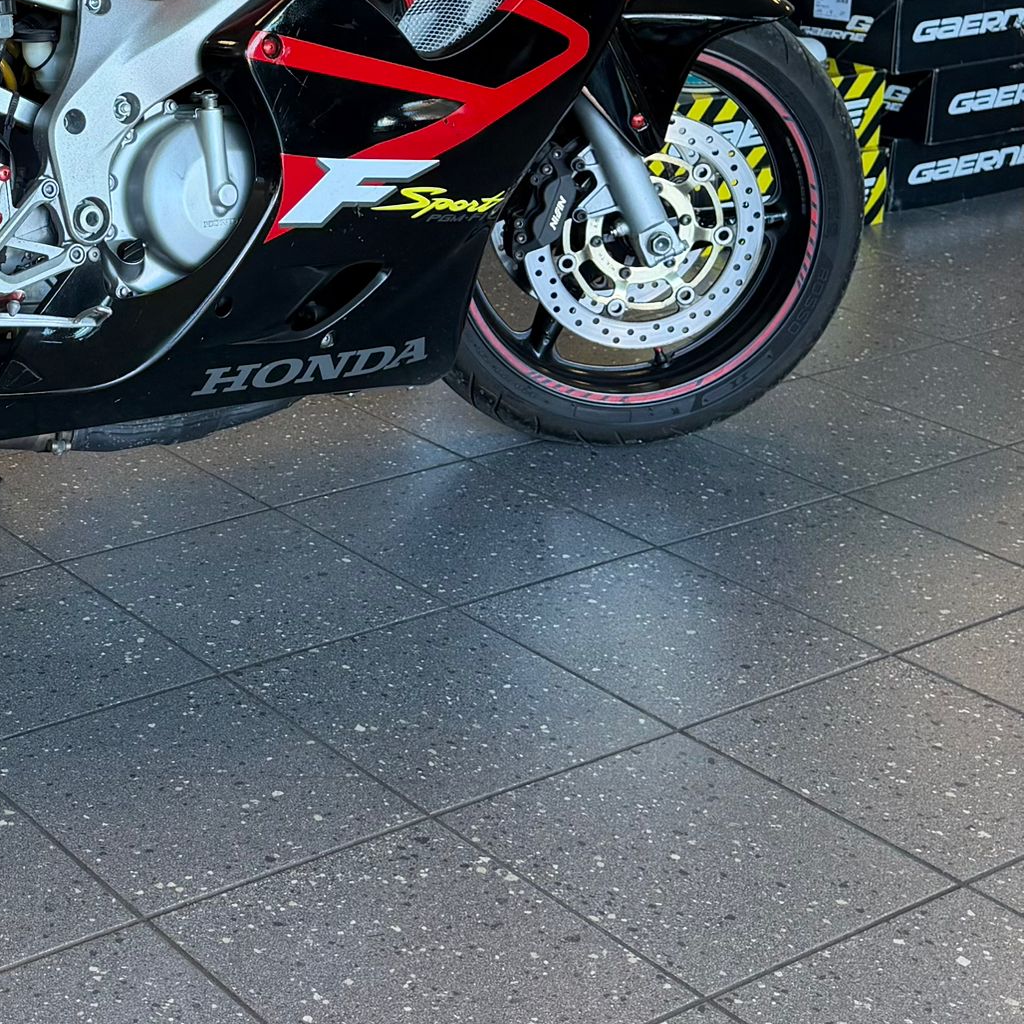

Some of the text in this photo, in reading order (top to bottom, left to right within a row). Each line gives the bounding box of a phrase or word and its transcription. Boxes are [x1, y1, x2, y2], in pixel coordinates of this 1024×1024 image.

[278, 158, 441, 228] F
[371, 186, 506, 219] Sport
[191, 336, 427, 397] HONDA
